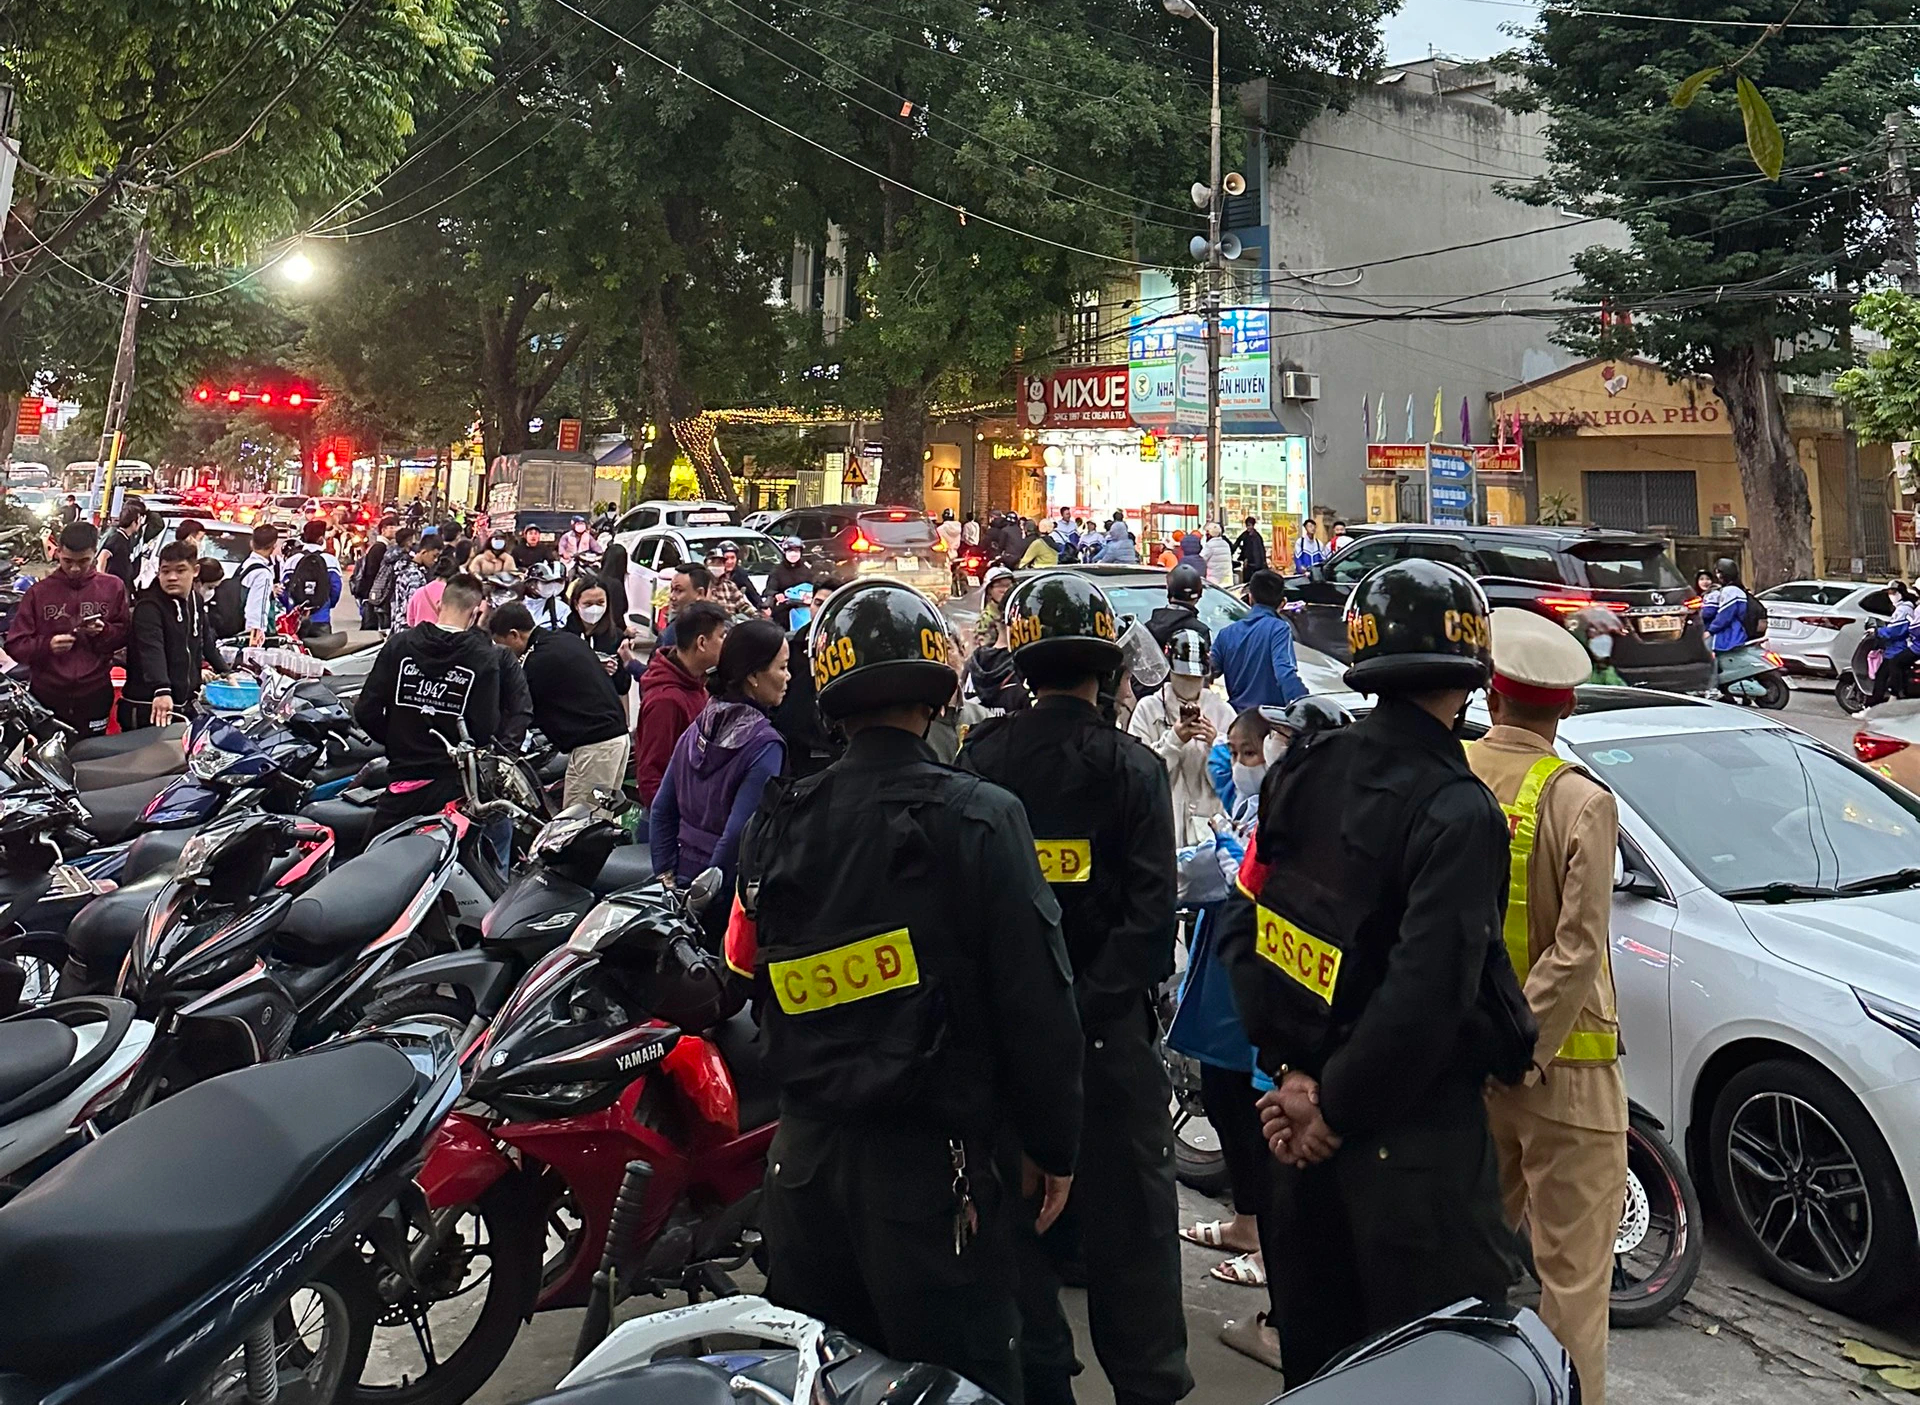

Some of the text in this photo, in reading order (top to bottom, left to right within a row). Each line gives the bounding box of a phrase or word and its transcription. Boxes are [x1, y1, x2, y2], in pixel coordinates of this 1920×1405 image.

[1053, 376, 1126, 408] MIXUE
[1157, 378, 1174, 397] NHÀ
[1605, 403, 1656, 425] HÓA
[1663, 399, 1719, 423] PHỐ
[1444, 609, 1491, 650] CSC
[416, 679, 447, 699] 1947
[1037, 849, 1081, 874] CĐ
[784, 944, 902, 1005] CSCĐ
[616, 1042, 665, 1072] YAMAHA
